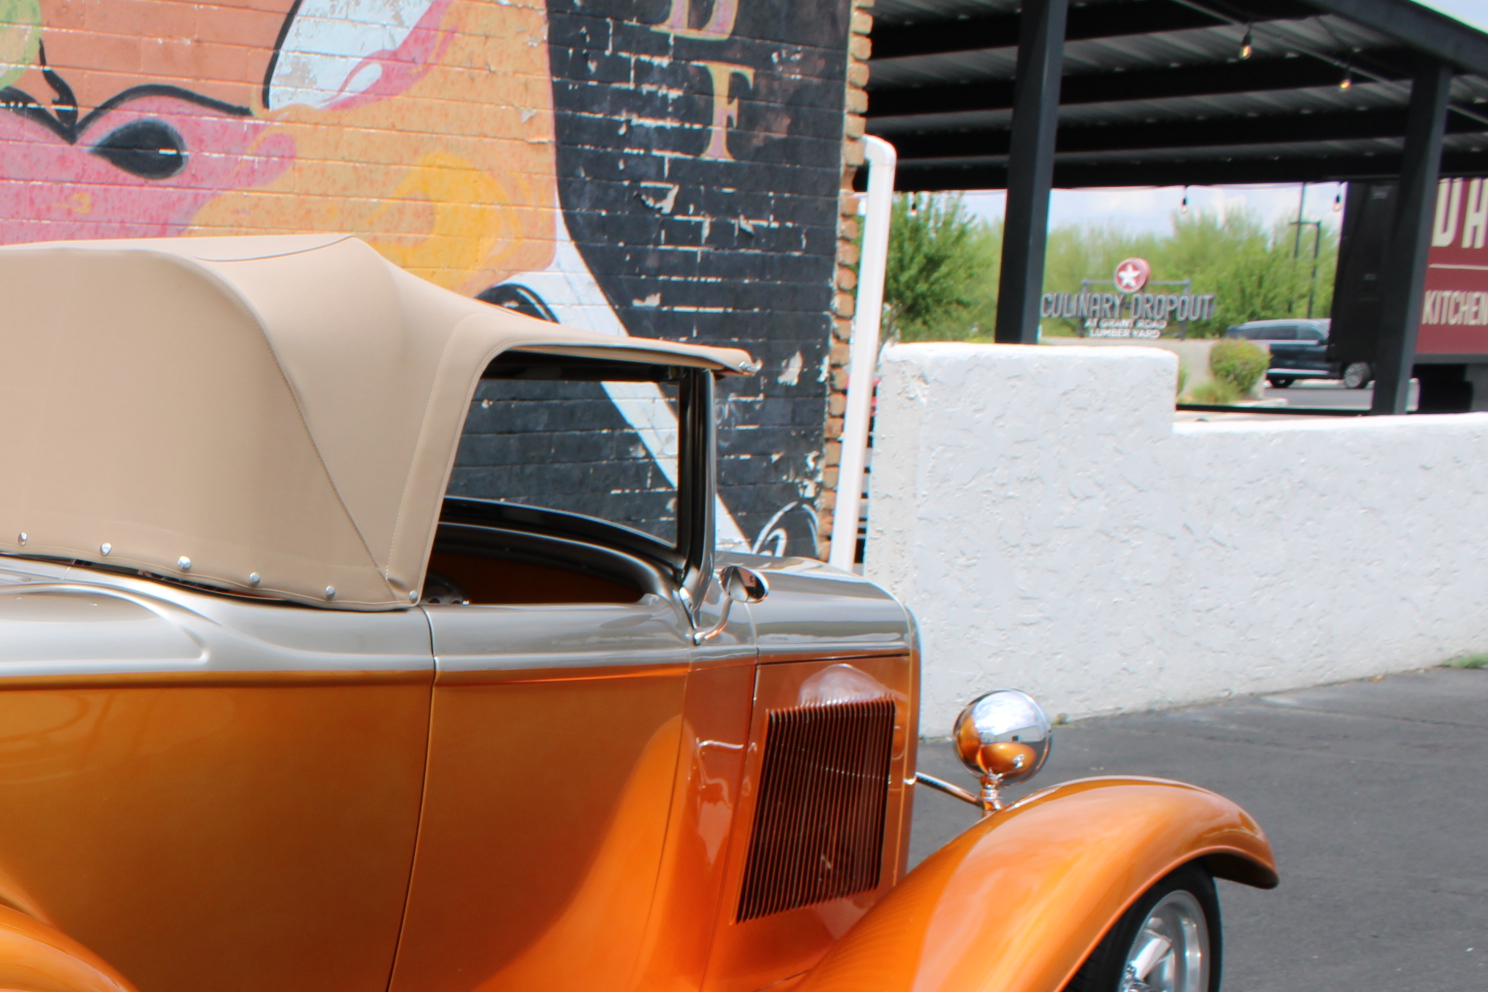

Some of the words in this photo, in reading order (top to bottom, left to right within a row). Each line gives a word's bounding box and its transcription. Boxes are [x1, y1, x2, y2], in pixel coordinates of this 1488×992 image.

[1040, 293, 1125, 319] CULINARY
[1130, 293, 1215, 321] DROPOUT
[1084, 318, 1098, 328] AT
[1098, 318, 1135, 328] GRANT
[1135, 319, 1168, 330] ROAD
[1088, 328, 1130, 338] LUMBER
[1130, 329, 1162, 339] YARD
